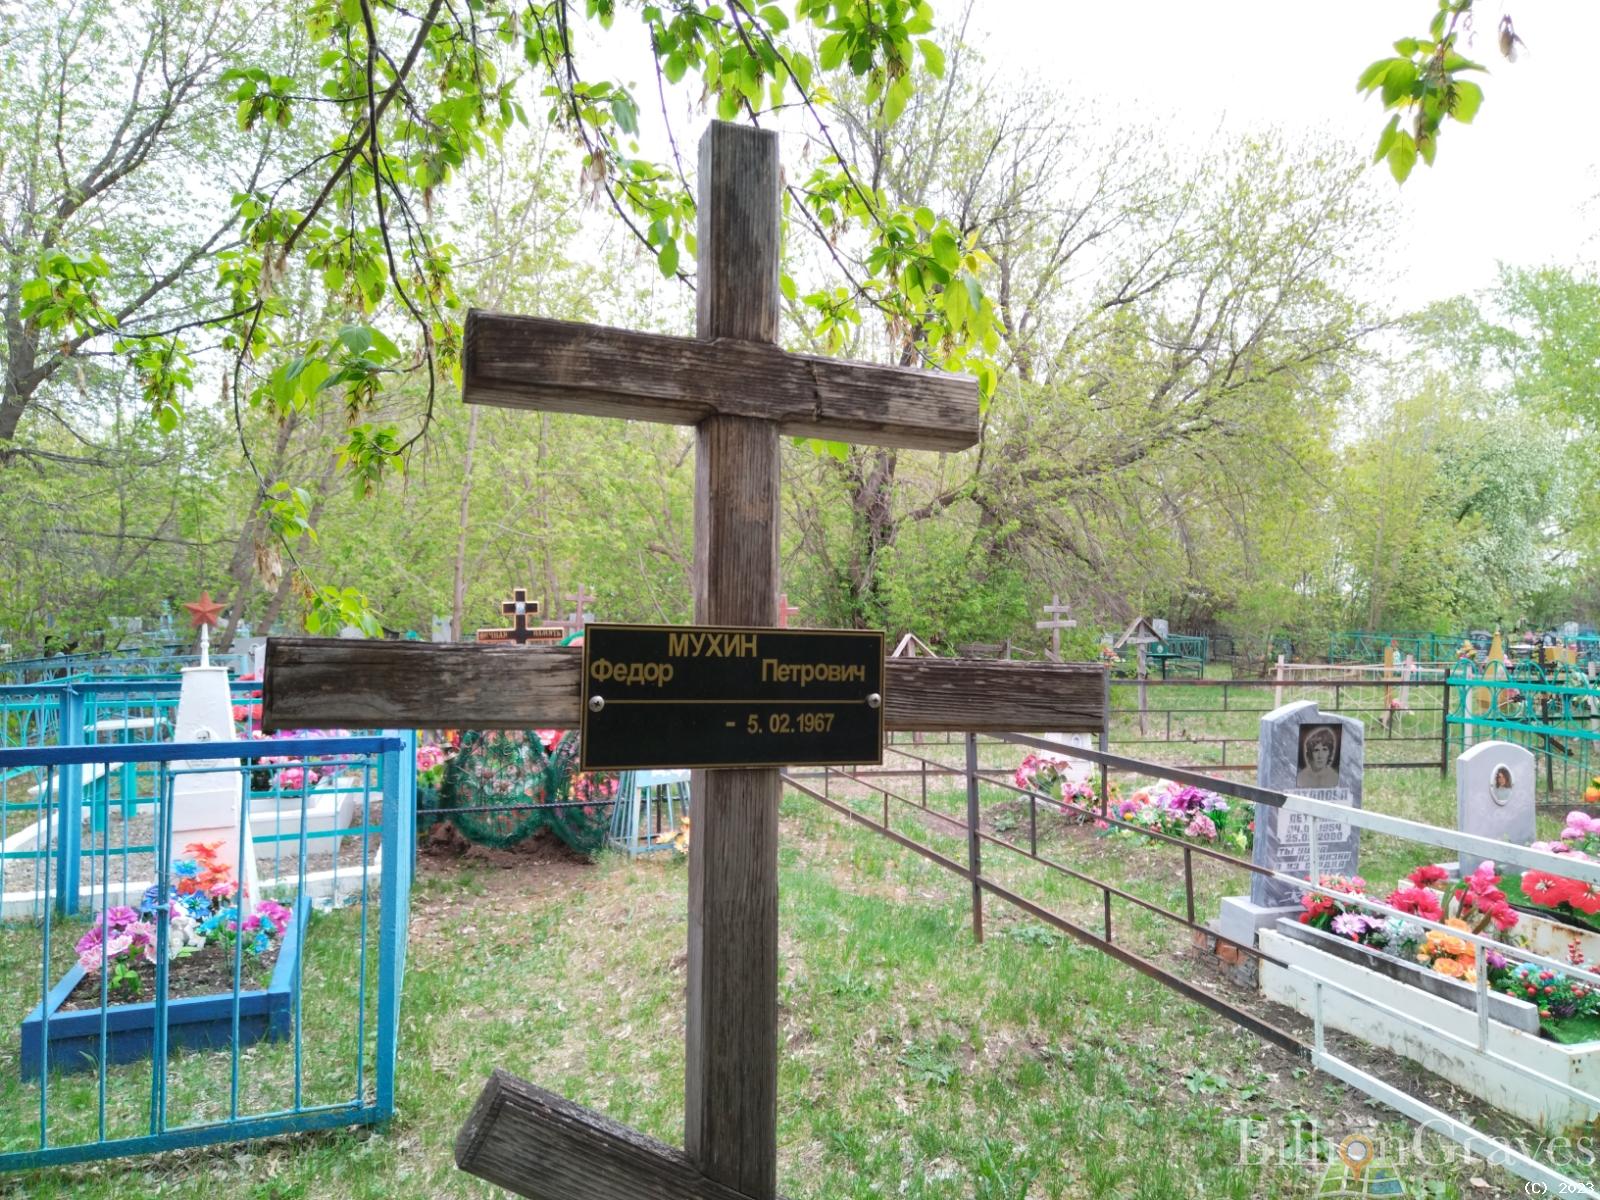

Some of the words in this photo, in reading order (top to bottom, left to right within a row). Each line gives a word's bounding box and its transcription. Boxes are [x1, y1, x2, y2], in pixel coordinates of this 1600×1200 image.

[668, 633, 758, 658] МУХИН
[590, 657, 674, 688] Федор
[762, 658, 866, 687] Петрович
[769, 712, 835, 734] 02.1967
